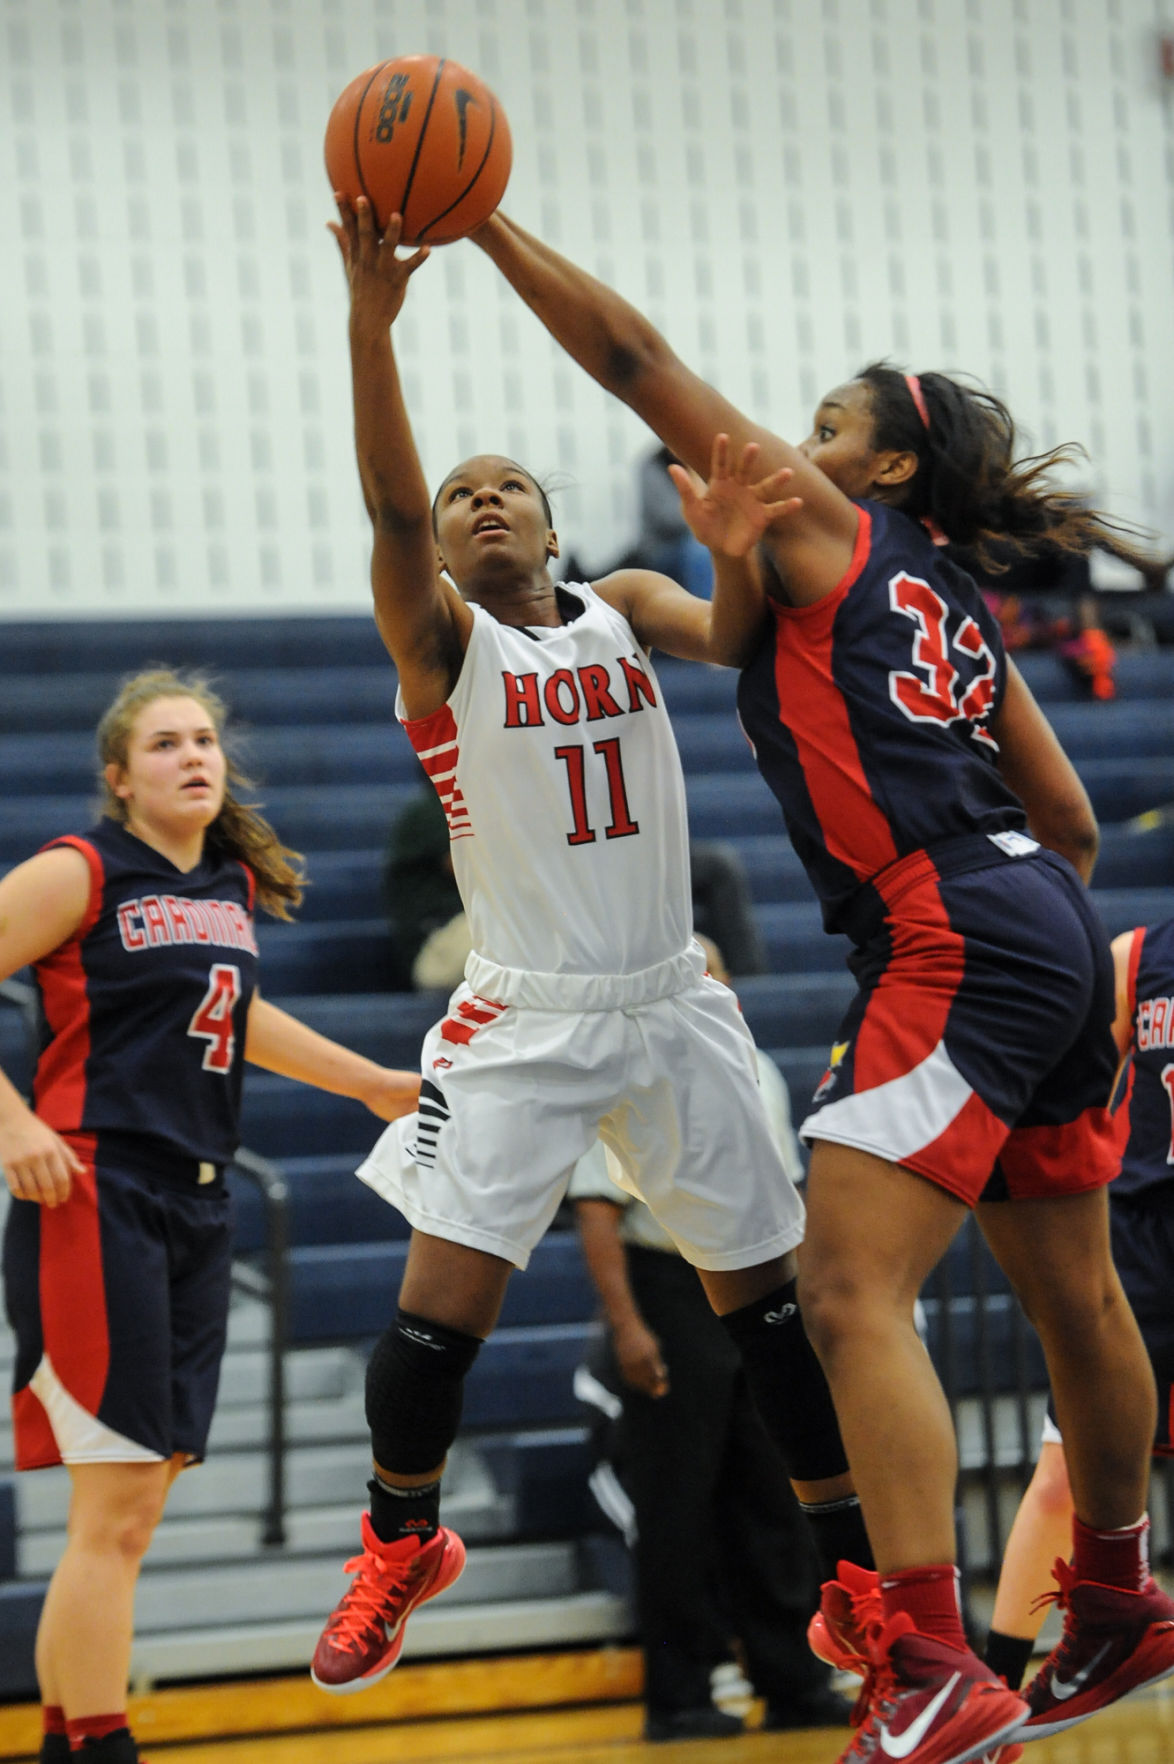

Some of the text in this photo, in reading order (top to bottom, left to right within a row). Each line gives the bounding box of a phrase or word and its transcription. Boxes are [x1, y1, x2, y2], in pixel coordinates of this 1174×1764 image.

[501, 653, 657, 728] HORN
[554, 737, 640, 845] 11
[187, 963, 242, 1075] 4
[1136, 996, 1174, 1052] CA
